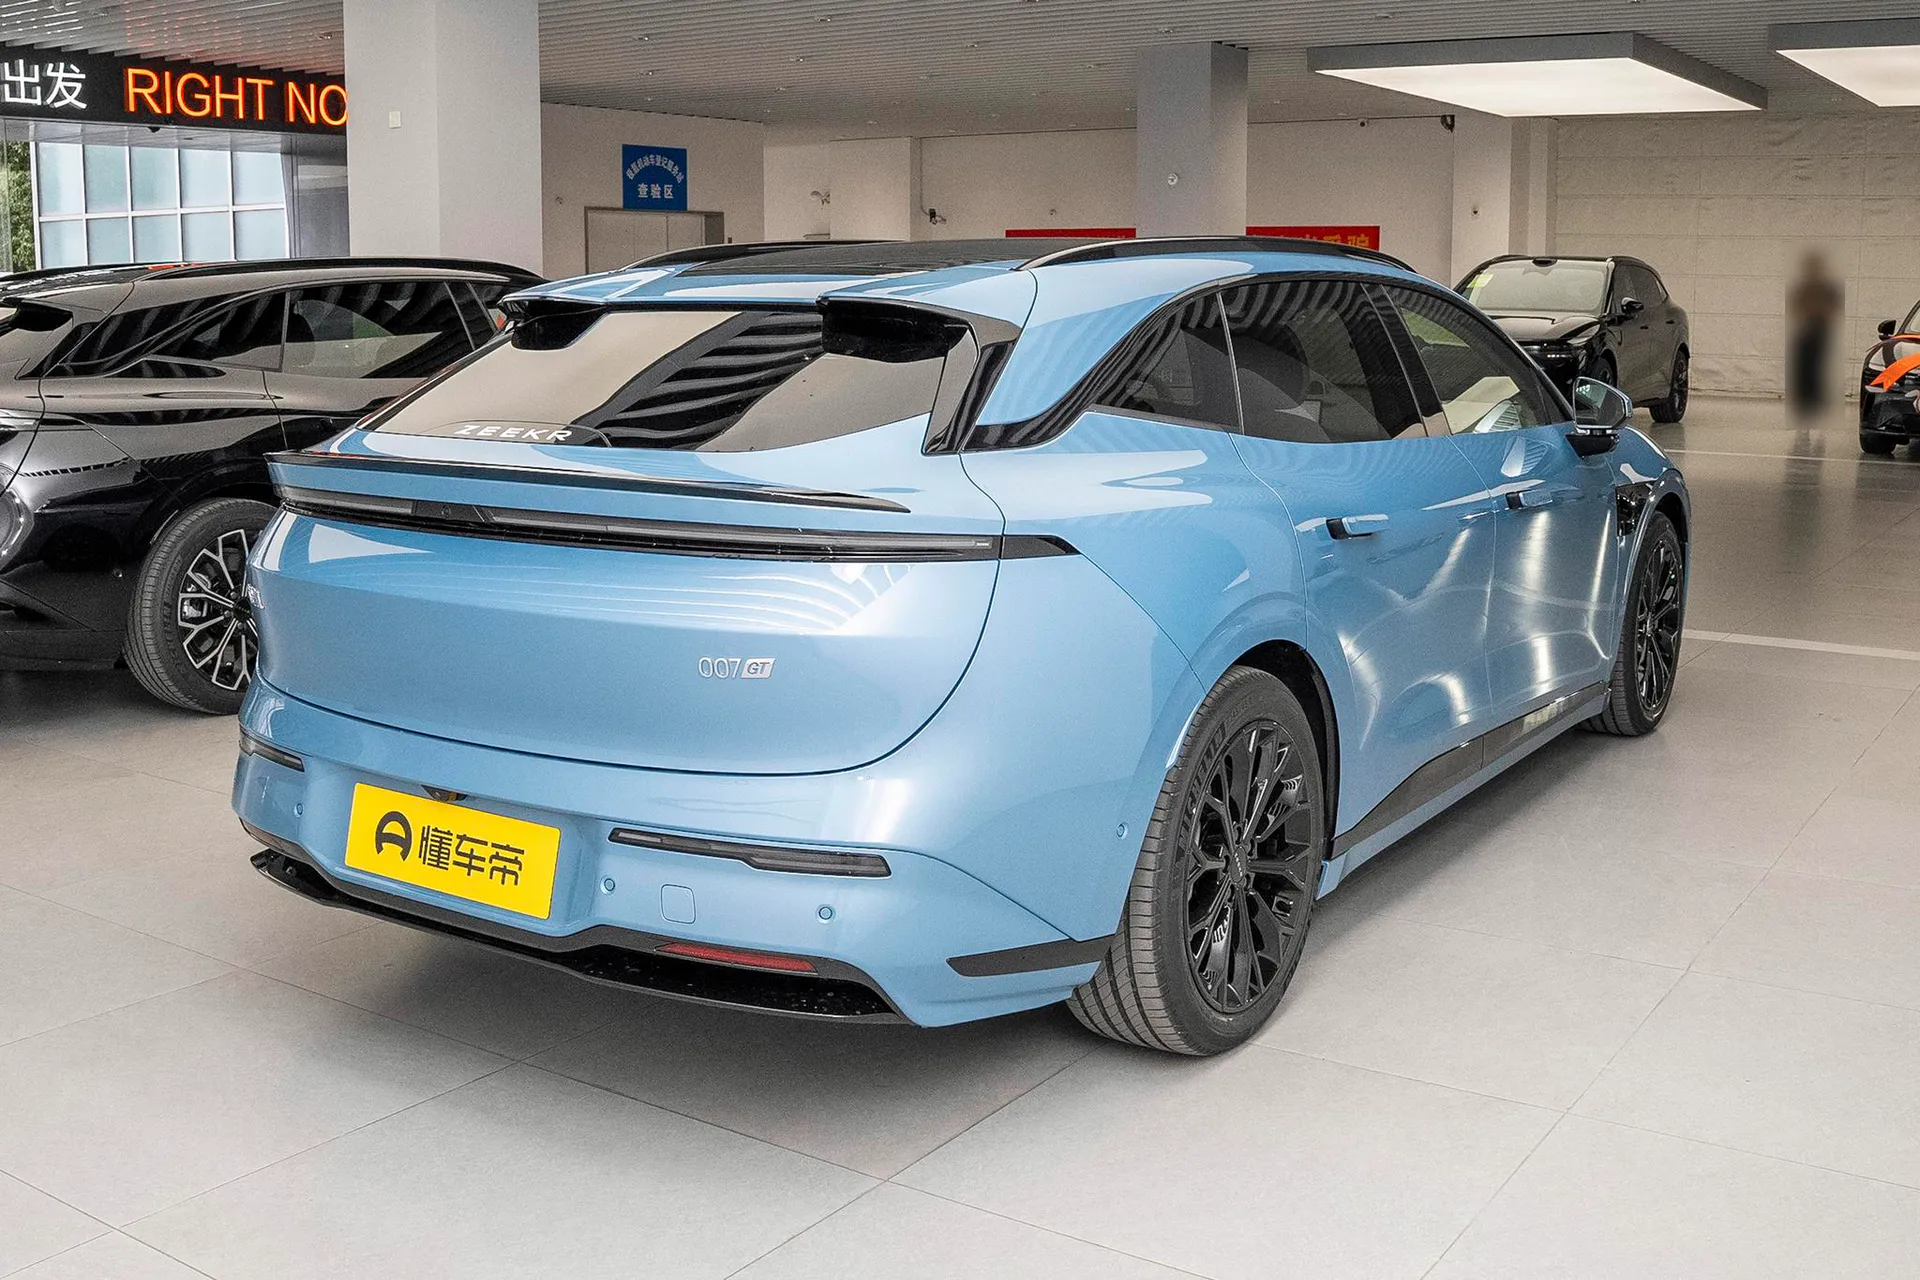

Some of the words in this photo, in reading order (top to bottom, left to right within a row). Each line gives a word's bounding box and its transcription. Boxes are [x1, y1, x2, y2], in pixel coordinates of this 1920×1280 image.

[4, 58, 88, 109] 出发
[126, 67, 274, 121] RIGHT
[287, 82, 347, 126] NO
[637, 182, 674, 199] 查验区
[454, 424, 573, 441] ZEEKR
[698, 656, 742, 679] 007
[745, 660, 772, 677] GT
[418, 825, 525, 886] 懂车帝
